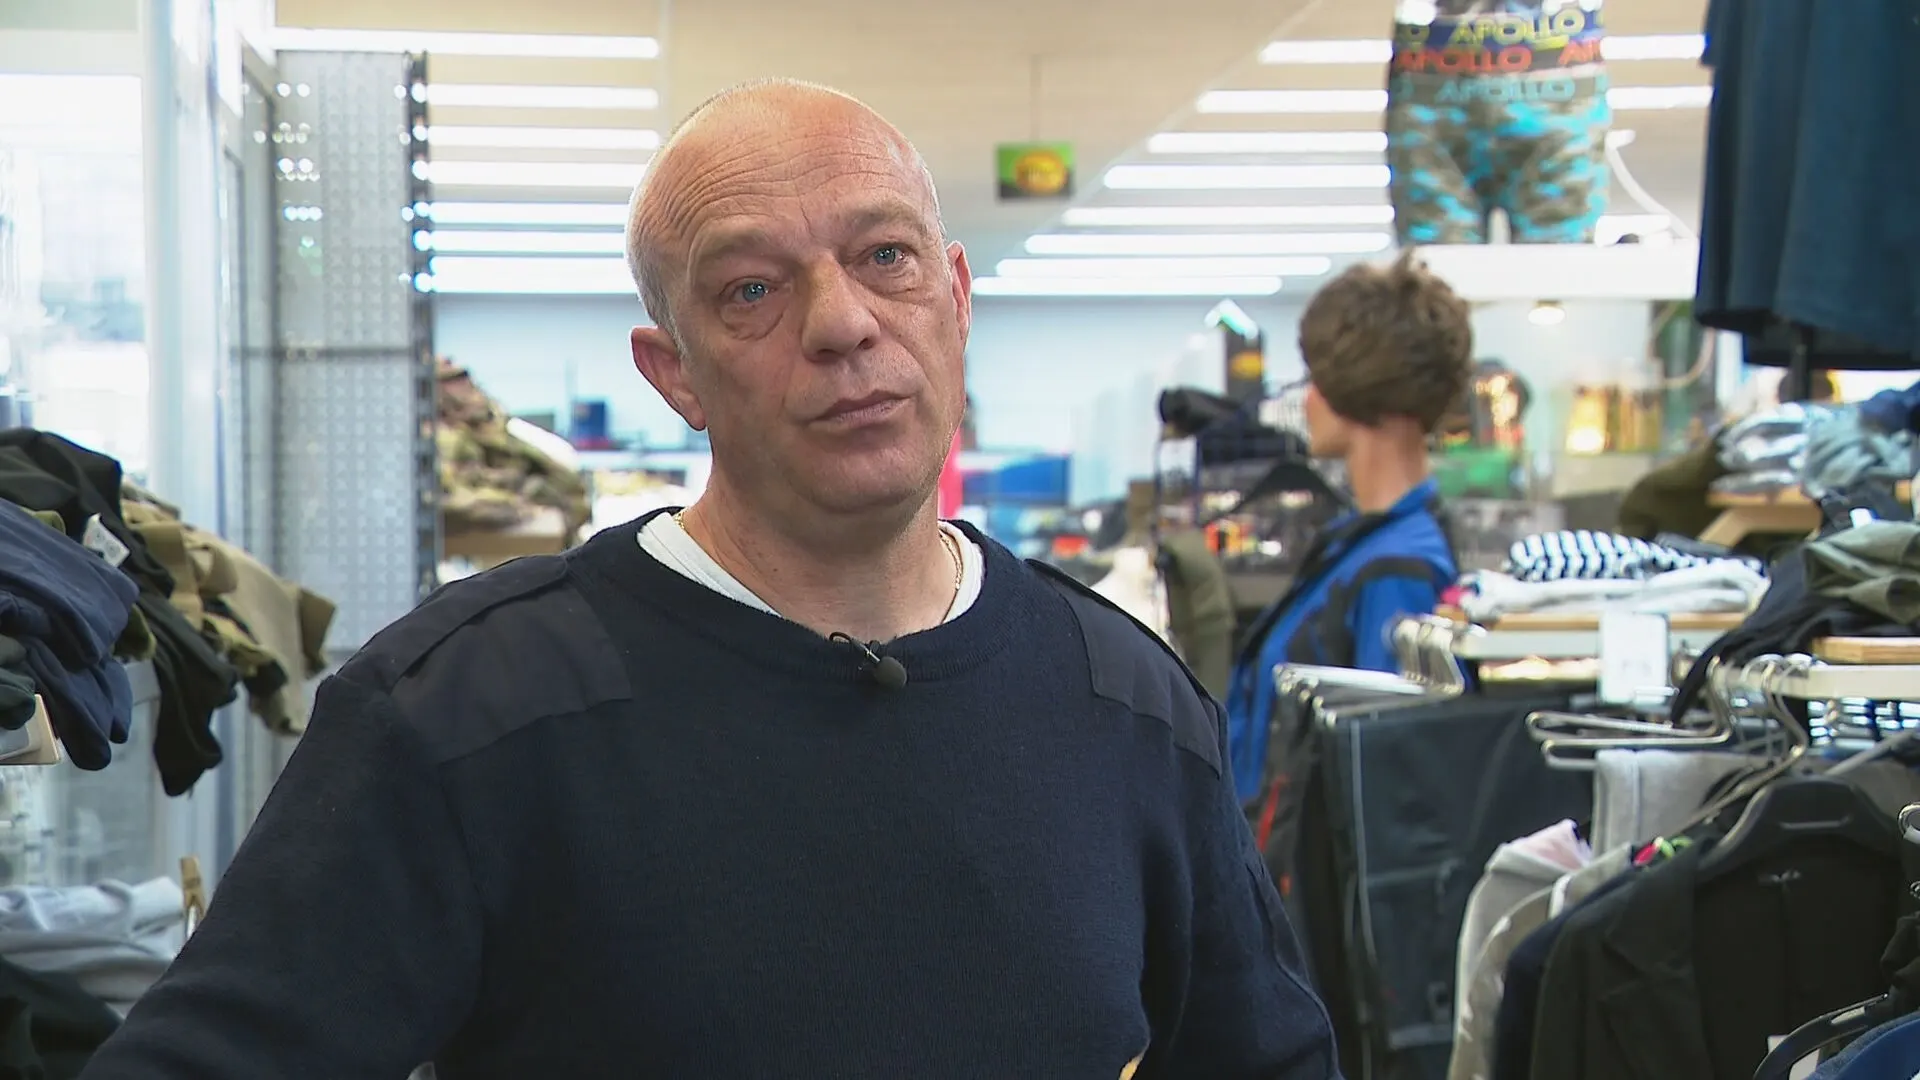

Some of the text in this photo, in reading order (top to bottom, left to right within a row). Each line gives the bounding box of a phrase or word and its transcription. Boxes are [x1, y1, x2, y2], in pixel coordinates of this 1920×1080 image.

[1448, 8, 1586, 46] APOLLO
[1396, 46, 1533, 73] APOLLO
[1435, 76, 1576, 103] APOLLO
